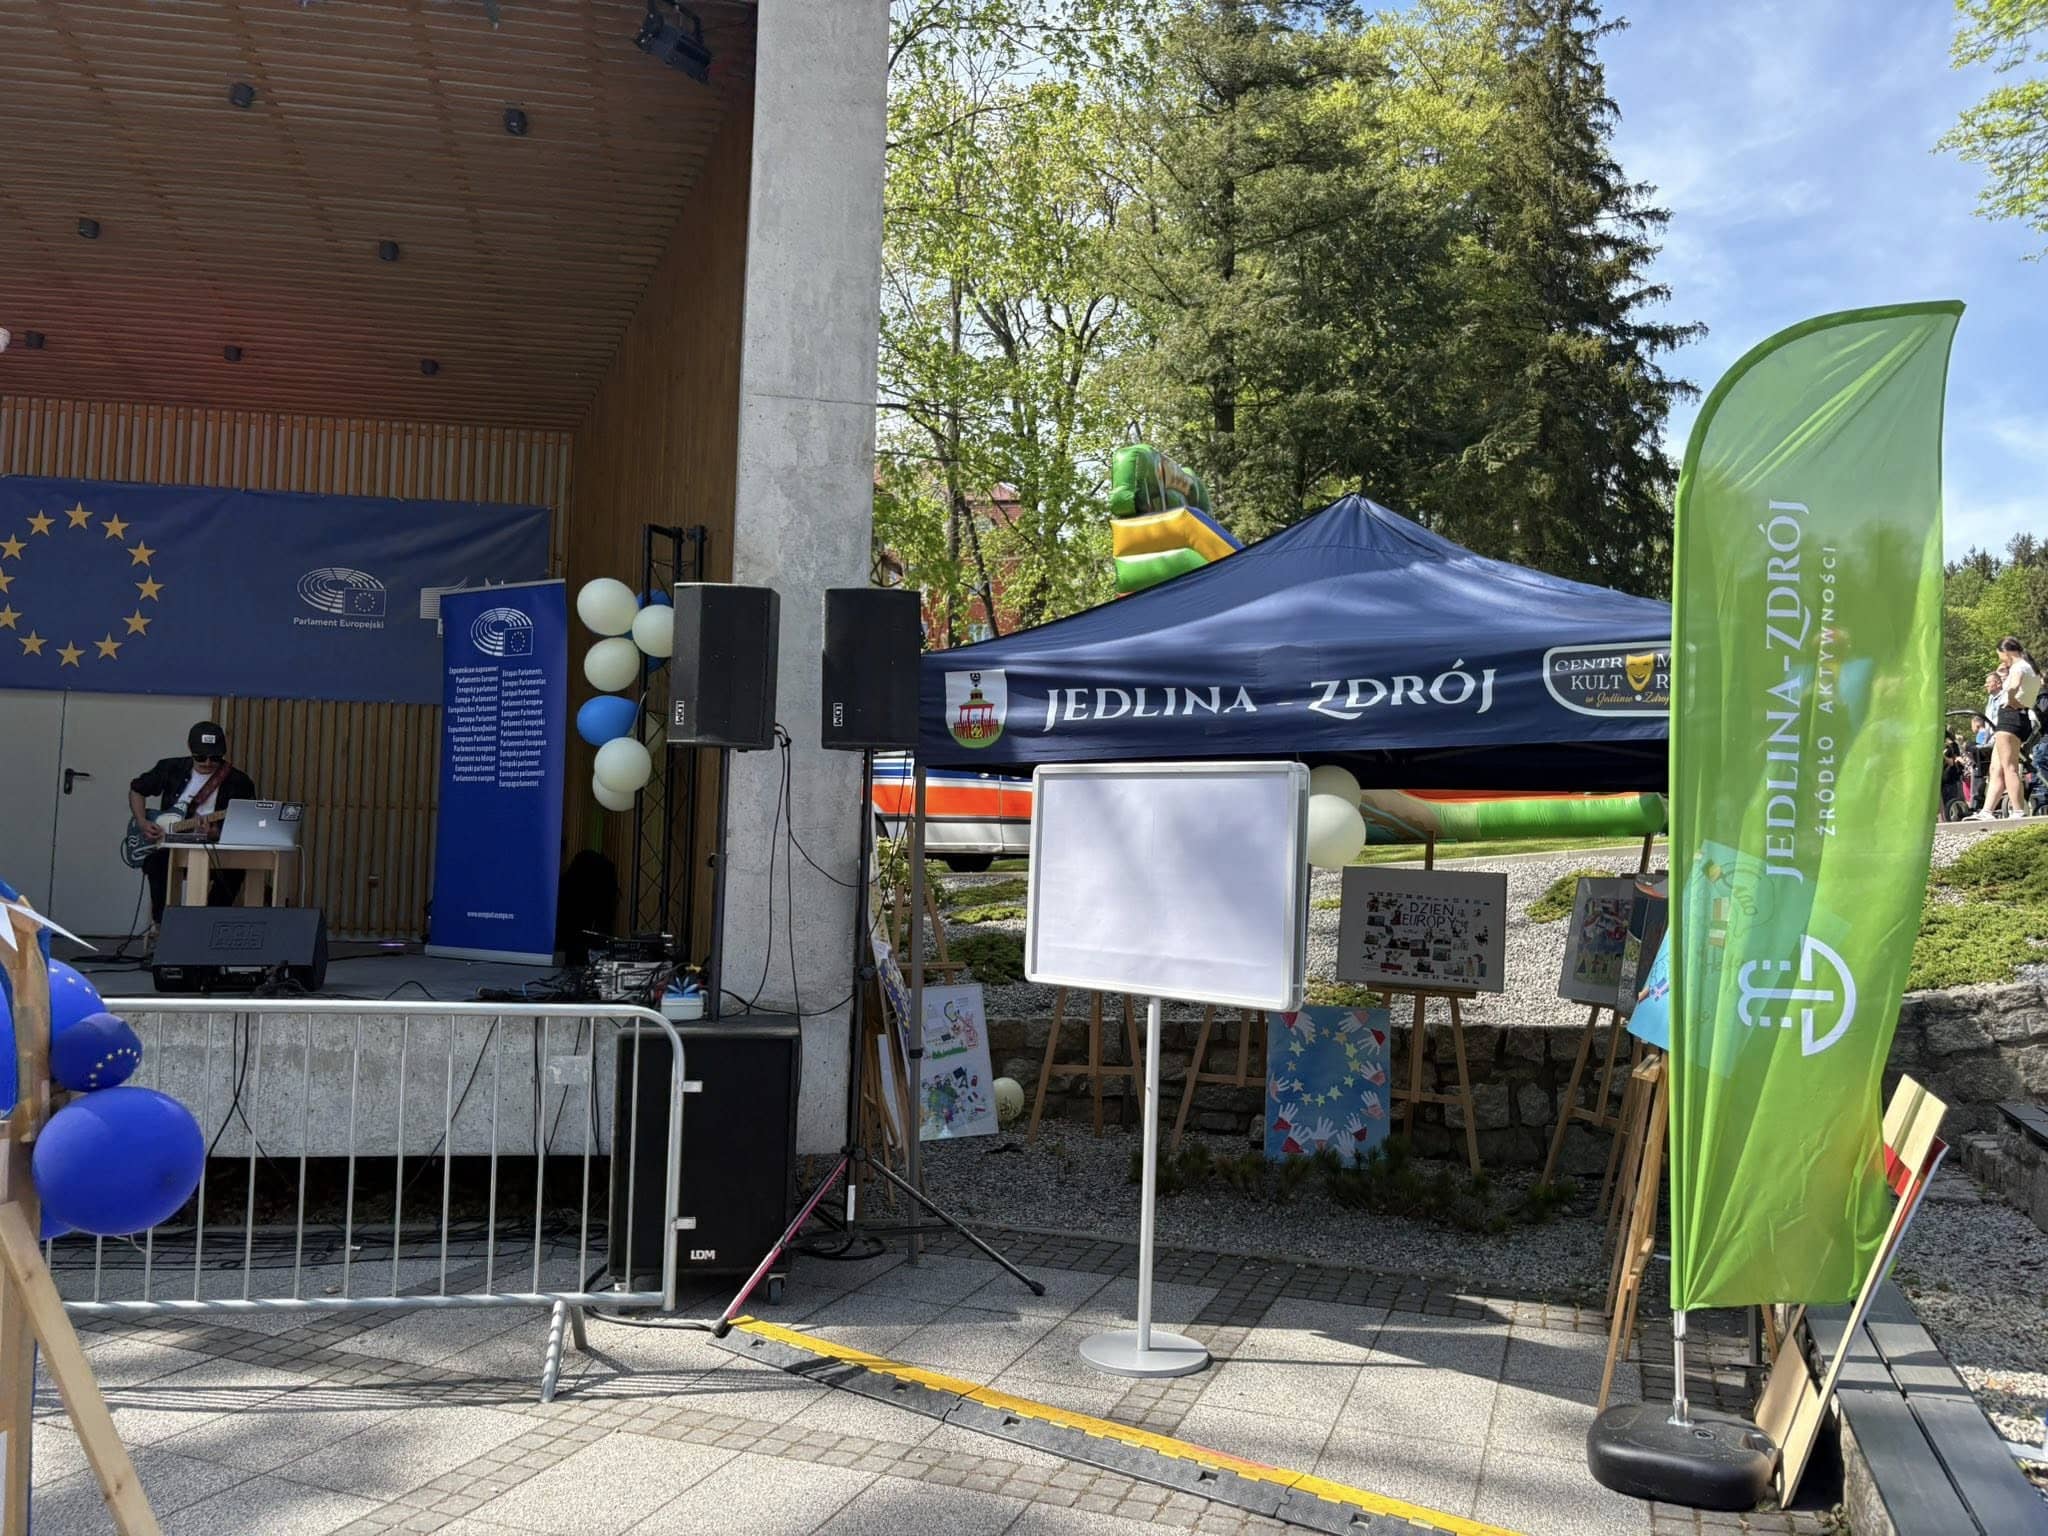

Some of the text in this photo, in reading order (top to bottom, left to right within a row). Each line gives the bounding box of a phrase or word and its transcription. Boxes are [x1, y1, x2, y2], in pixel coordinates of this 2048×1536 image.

[294, 617, 384, 630] Parlament Europejski
[1043, 685, 1258, 732] JEDLINA
[1307, 658, 1498, 720] ZDRÓJ
[1757, 499, 1811, 885] JEDLINA-ZDRÓJ
[1815, 547, 1836, 837] ŹRÓDŁO AKTYWNOŚCI
[676, 702, 684, 725] LDM
[833, 704, 842, 726] LDM
[690, 1249, 716, 1260] LDM
